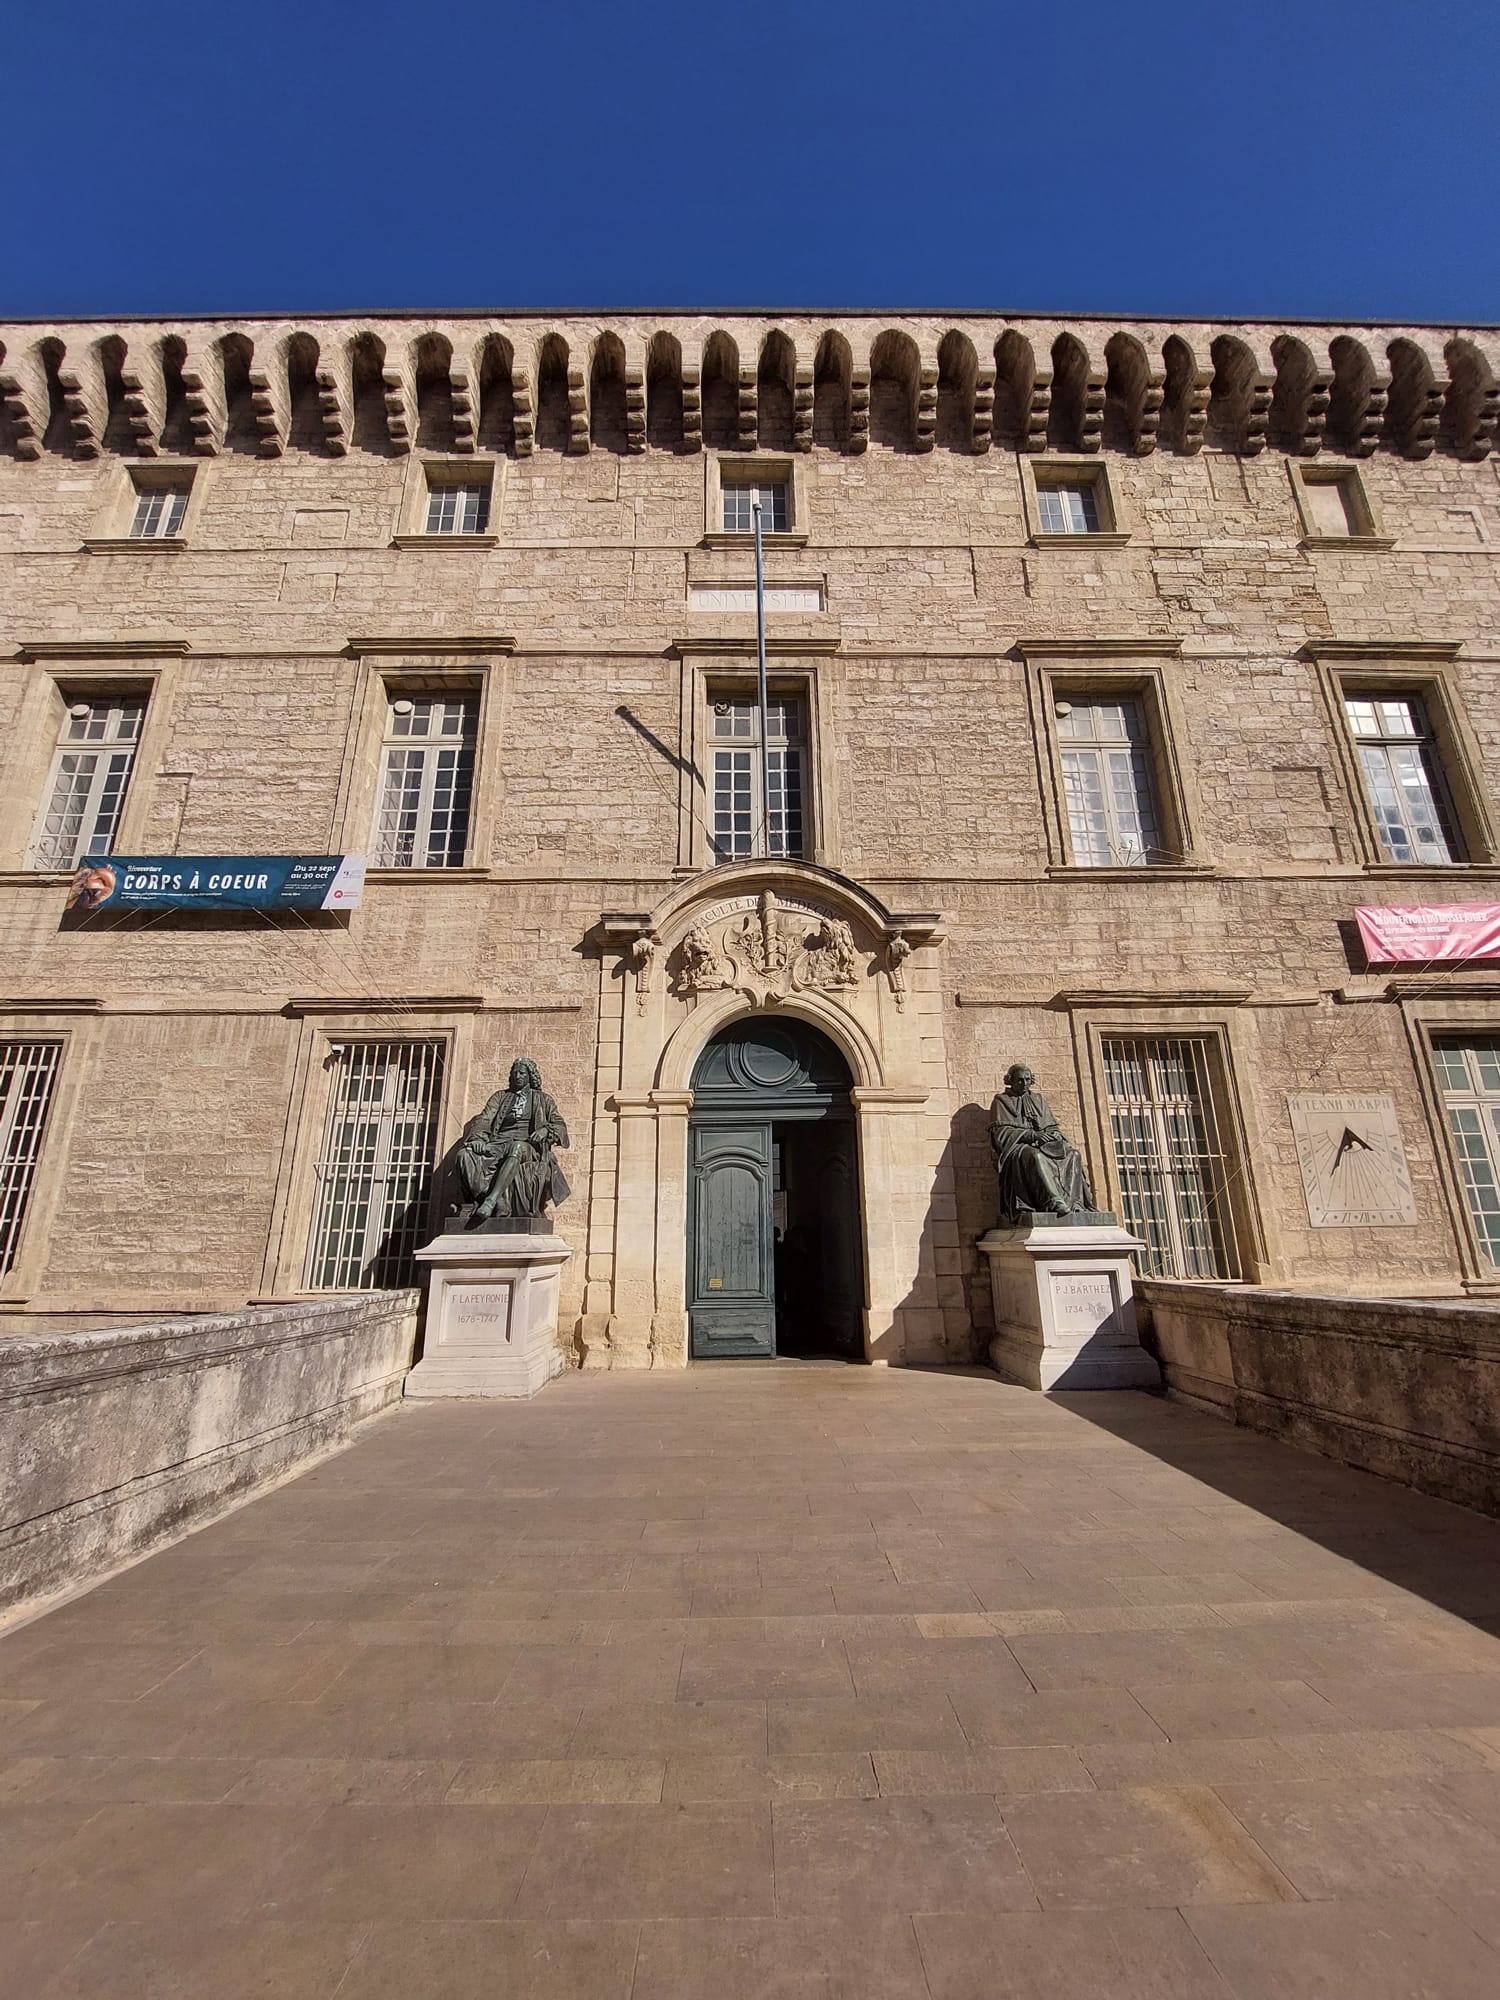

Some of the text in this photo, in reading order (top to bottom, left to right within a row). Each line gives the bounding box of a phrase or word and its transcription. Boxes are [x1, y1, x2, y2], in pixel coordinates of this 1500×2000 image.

[698, 593, 815, 610] UNIVESITE
[123, 874, 183, 890] CORPS
[189, 871, 200, 889] À
[208, 874, 268, 890] COEUR
